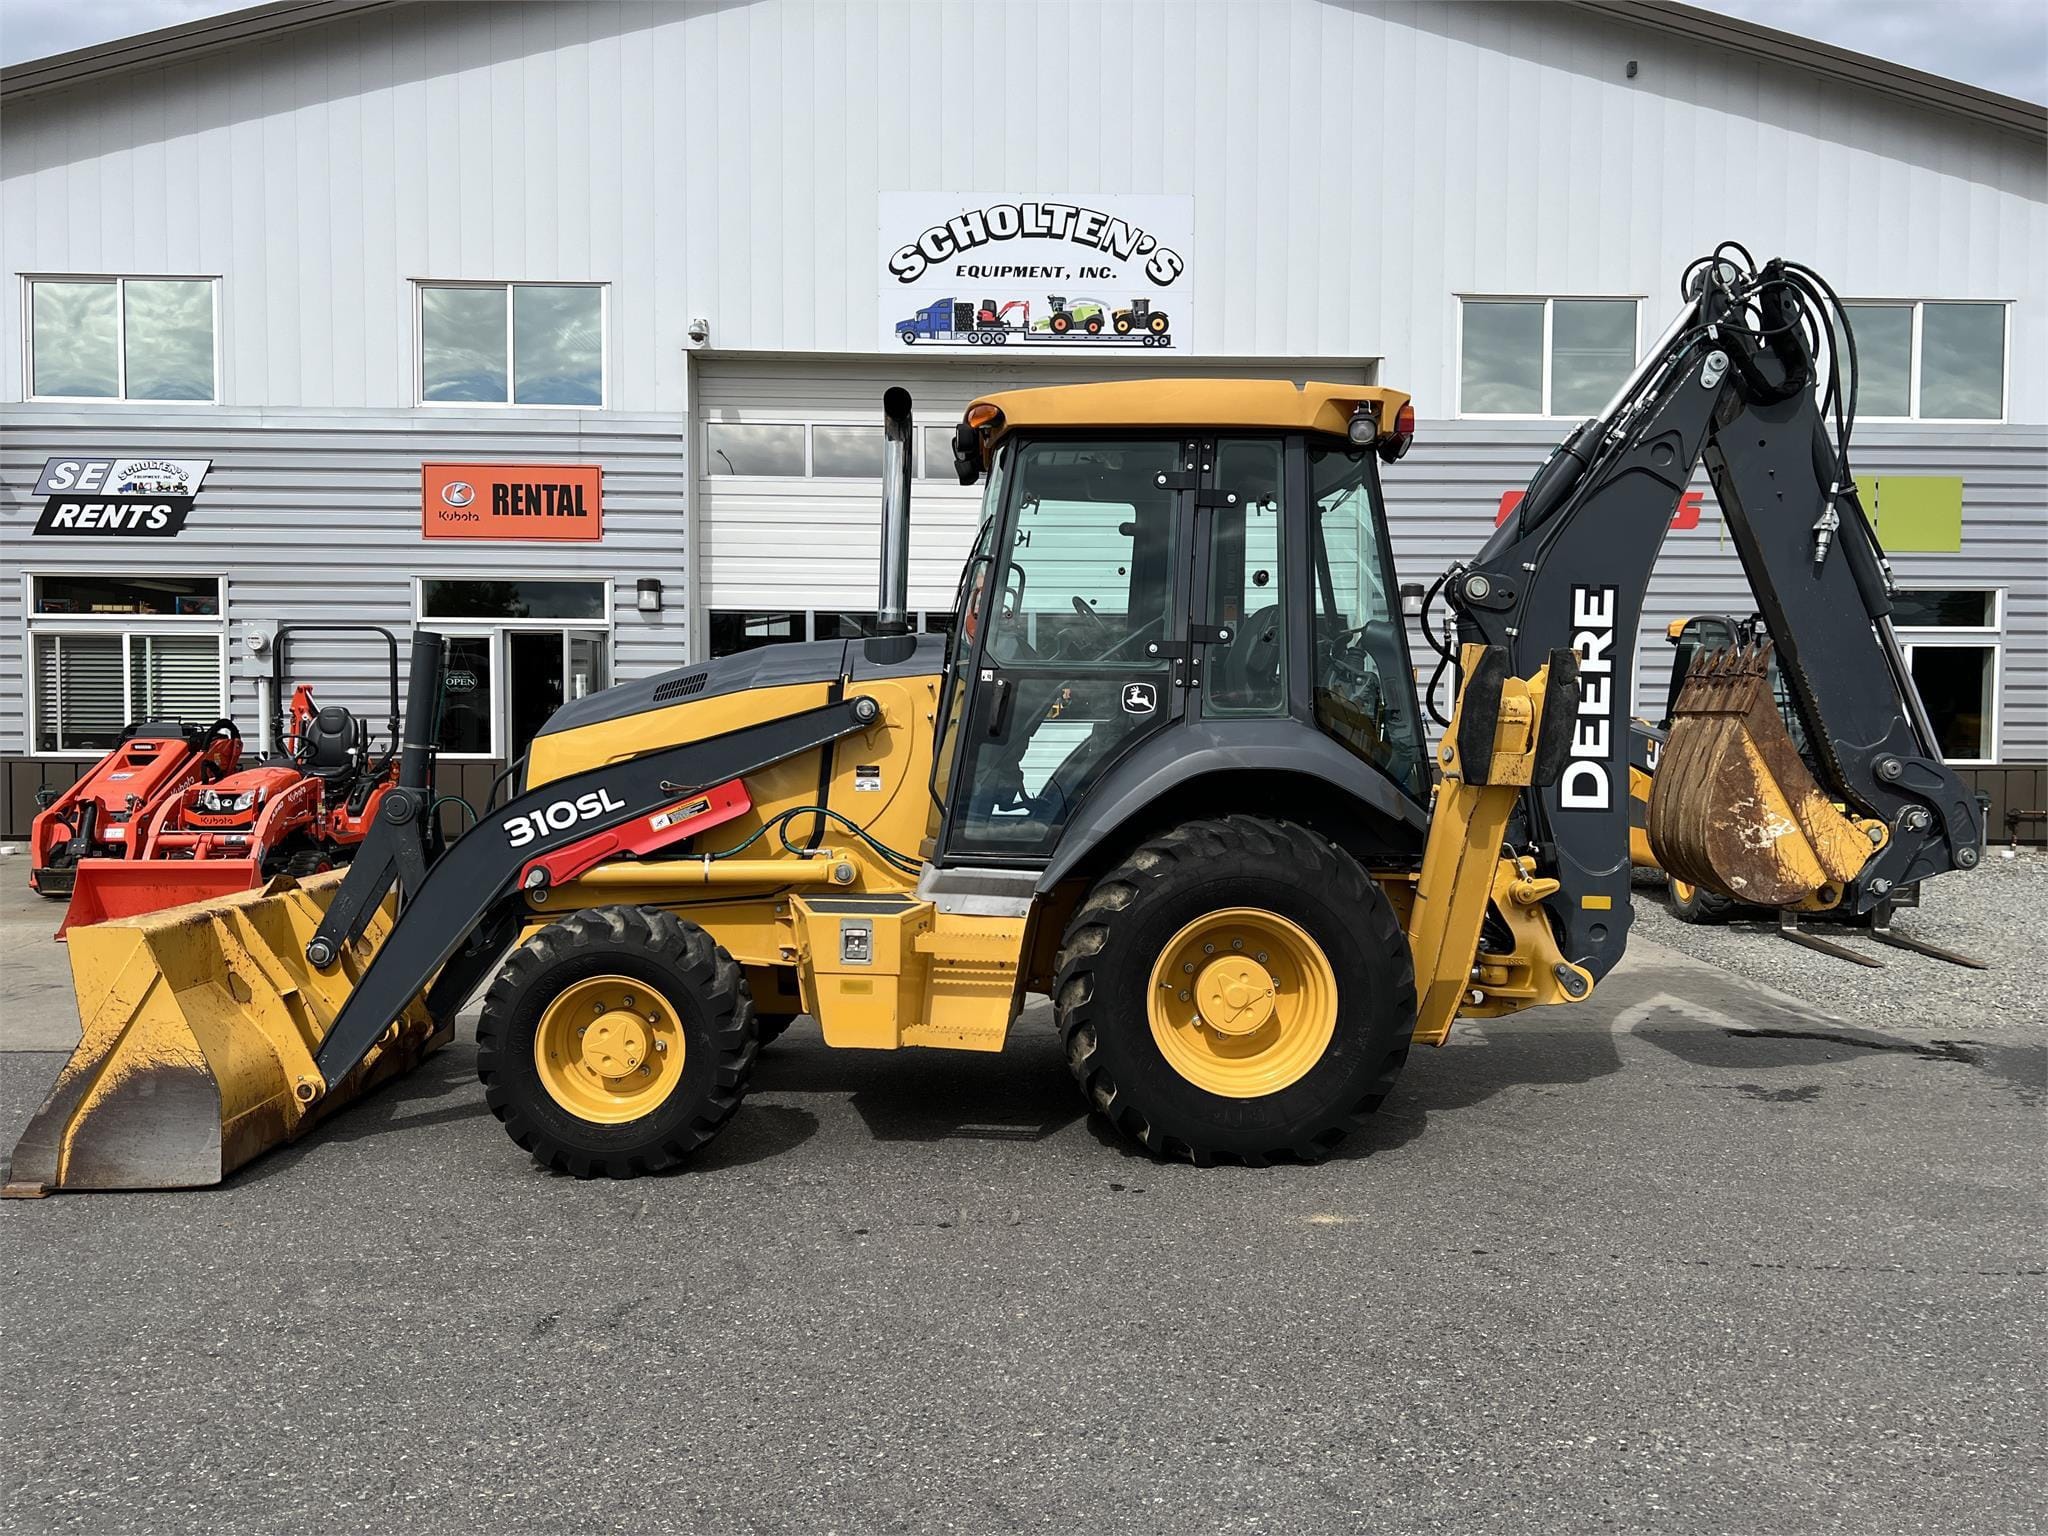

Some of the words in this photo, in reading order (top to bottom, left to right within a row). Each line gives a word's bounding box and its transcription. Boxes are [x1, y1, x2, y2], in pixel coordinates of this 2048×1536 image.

[888, 202, 1185, 287] SCHOLTEN'S
[955, 264, 1072, 280] EQUIPMENT,
[1079, 266, 1118, 280] INC.
[47, 461, 110, 491] SE
[492, 483, 588, 517] RENTAL
[50, 503, 172, 529] RENTS
[438, 510, 480, 522] Kubota
[445, 678, 475, 686] OPEN
[1560, 588, 1616, 810] DEERE
[200, 816, 233, 825] Kubota
[502, 787, 627, 848] 310SL
